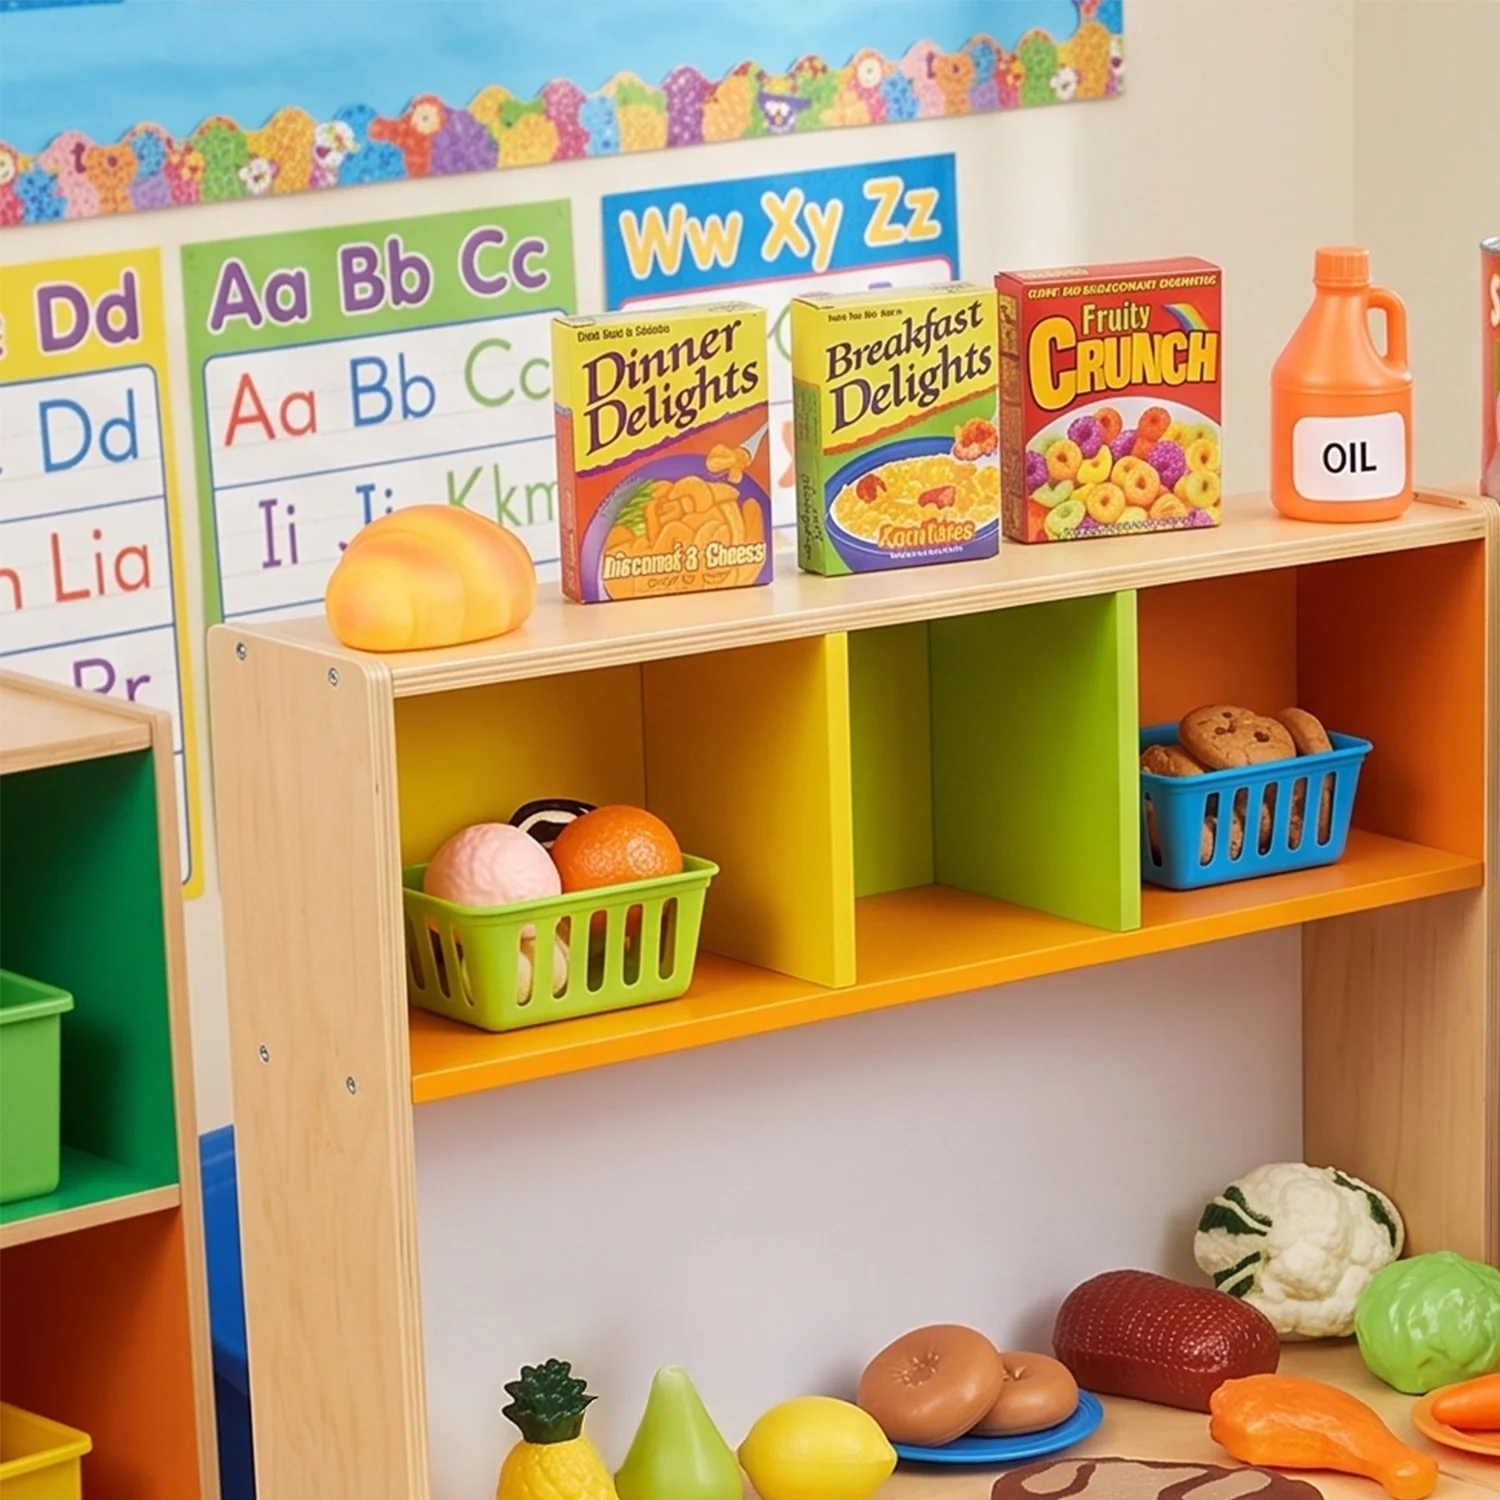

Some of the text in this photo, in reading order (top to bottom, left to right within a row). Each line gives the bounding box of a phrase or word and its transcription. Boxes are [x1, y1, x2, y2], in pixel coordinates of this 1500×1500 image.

[619, 176, 941, 280] Ww Xy Zz
[36, 271, 140, 352] Dd
[209, 229, 548, 331] Aa Bb Cc
[1083, 302, 1150, 335] Fruity
[582, 320, 742, 407] Dinner
[826, 300, 983, 383] Breakfast
[1029, 316, 1218, 411] CRUNCH
[39, 389, 139, 473] Dd
[225, 338, 550, 447] Aa Bb Cc
[584, 361, 759, 456] Delights
[830, 343, 992, 434] Delights
[1323, 441, 1377, 474] OIL
